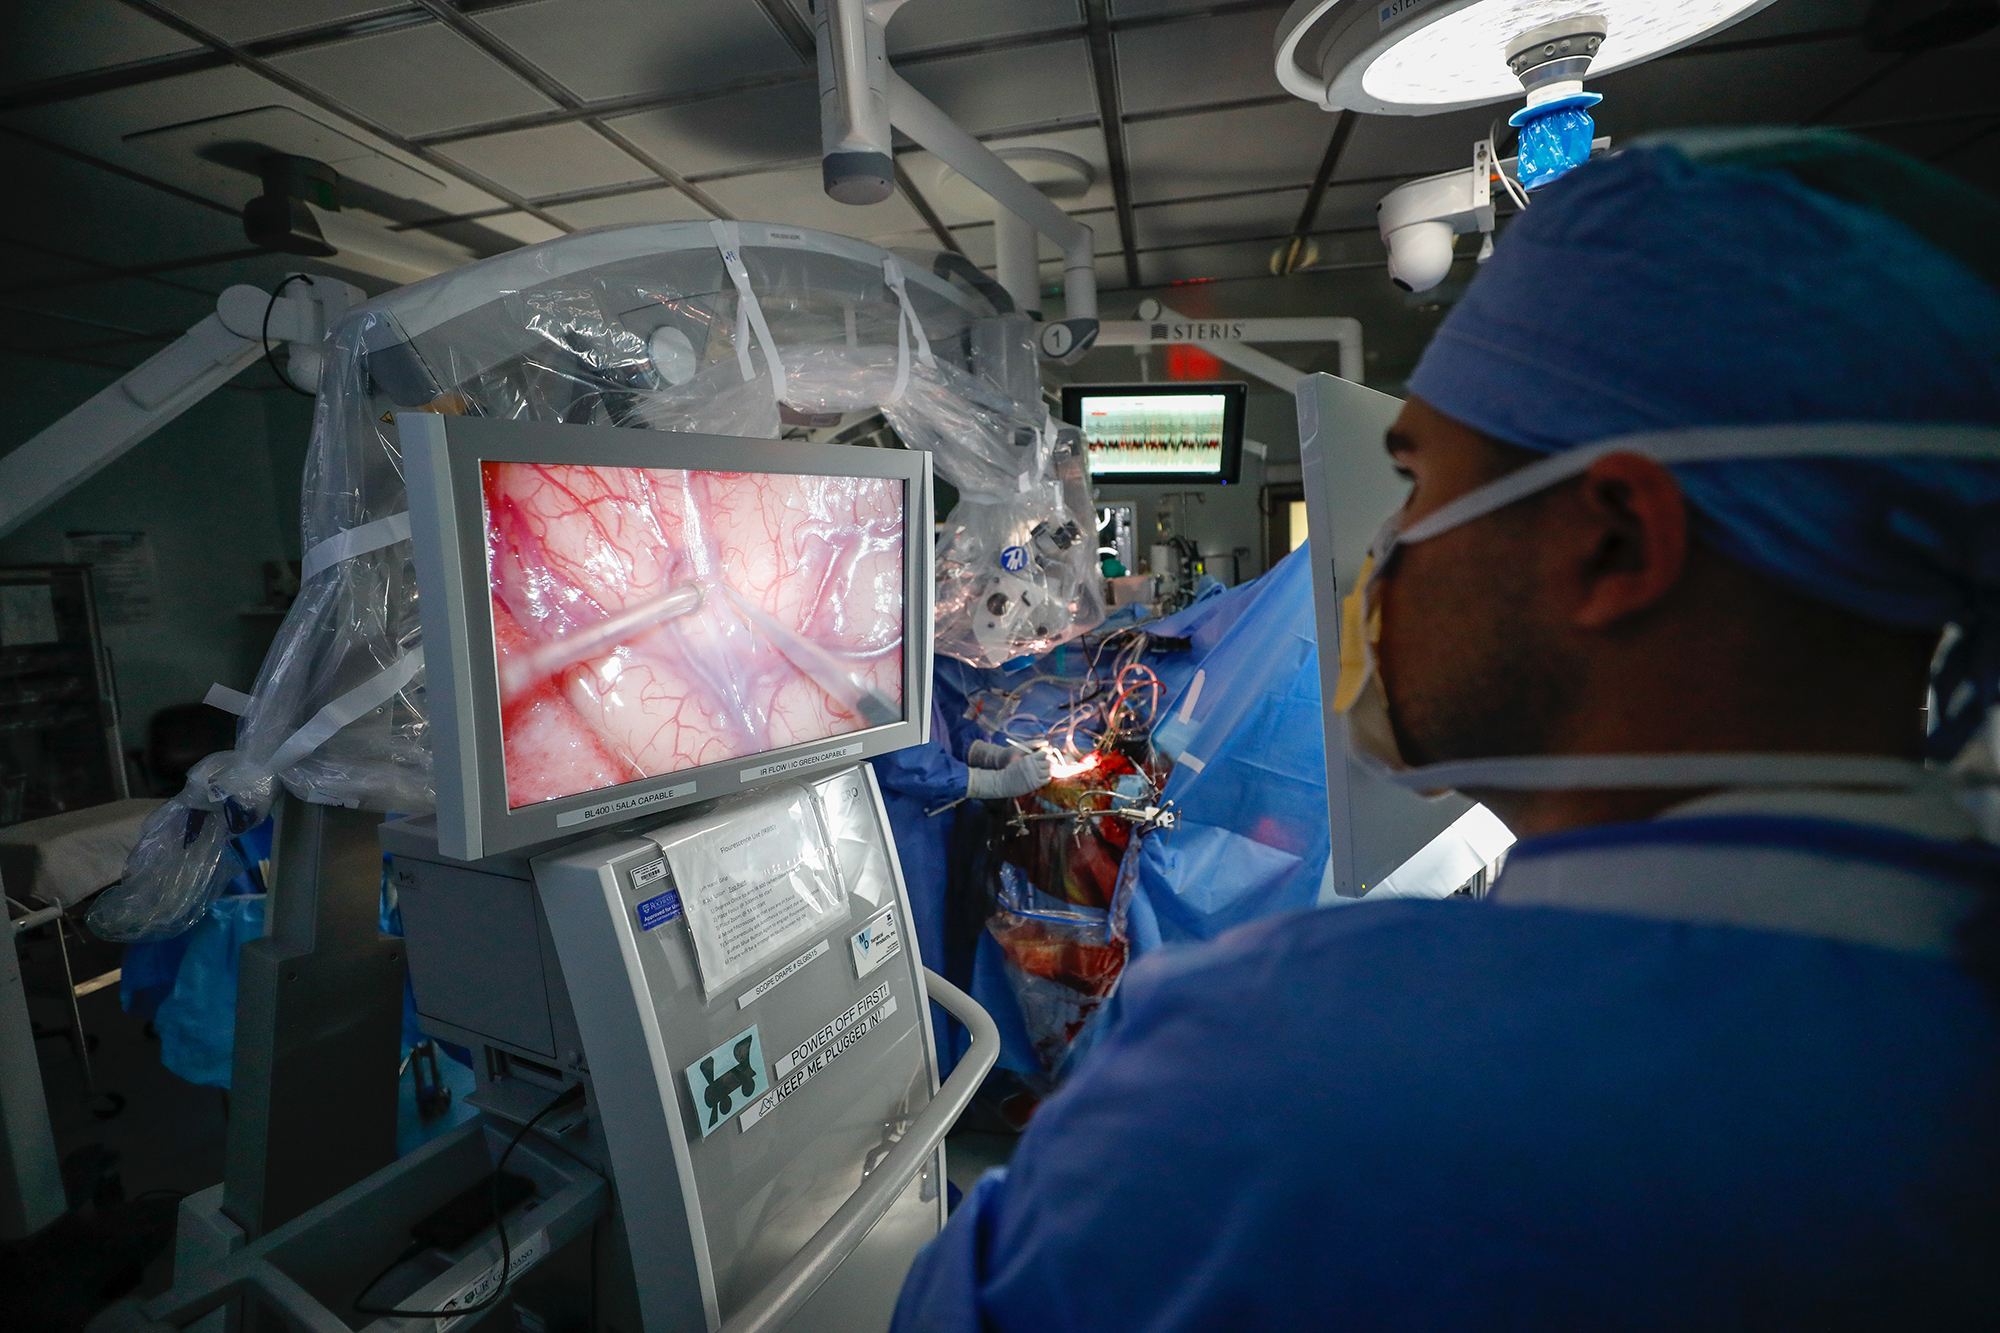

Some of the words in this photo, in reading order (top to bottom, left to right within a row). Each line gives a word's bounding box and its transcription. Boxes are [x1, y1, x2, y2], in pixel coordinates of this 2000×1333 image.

[1052, 329, 1060, 348] 1
[1174, 323, 1242, 340] STERIS
[760, 768, 767, 776] IR
[768, 763, 787, 774] FLOW
[799, 756, 820, 767] GREEN
[821, 749, 847, 761] CAPABLE
[584, 805, 610, 819] BL400
[616, 799, 637, 811] 5ALA
[638, 790, 674, 805] CAPABLE
[644, 909, 665, 922] Approved
[858, 932, 866, 944] M
[864, 940, 870, 950] D
[756, 977, 775, 995] SCOPE
[775, 965, 793, 982] DRAPE
[791, 1026, 834, 1066] POWER
[835, 1007, 856, 1032] OFF
[857, 984, 888, 1015] FIRST!
[776, 1071, 804, 1103] KEEP
[807, 1057, 823, 1077] ME
[825, 1023, 867, 1063] PLUGGED
